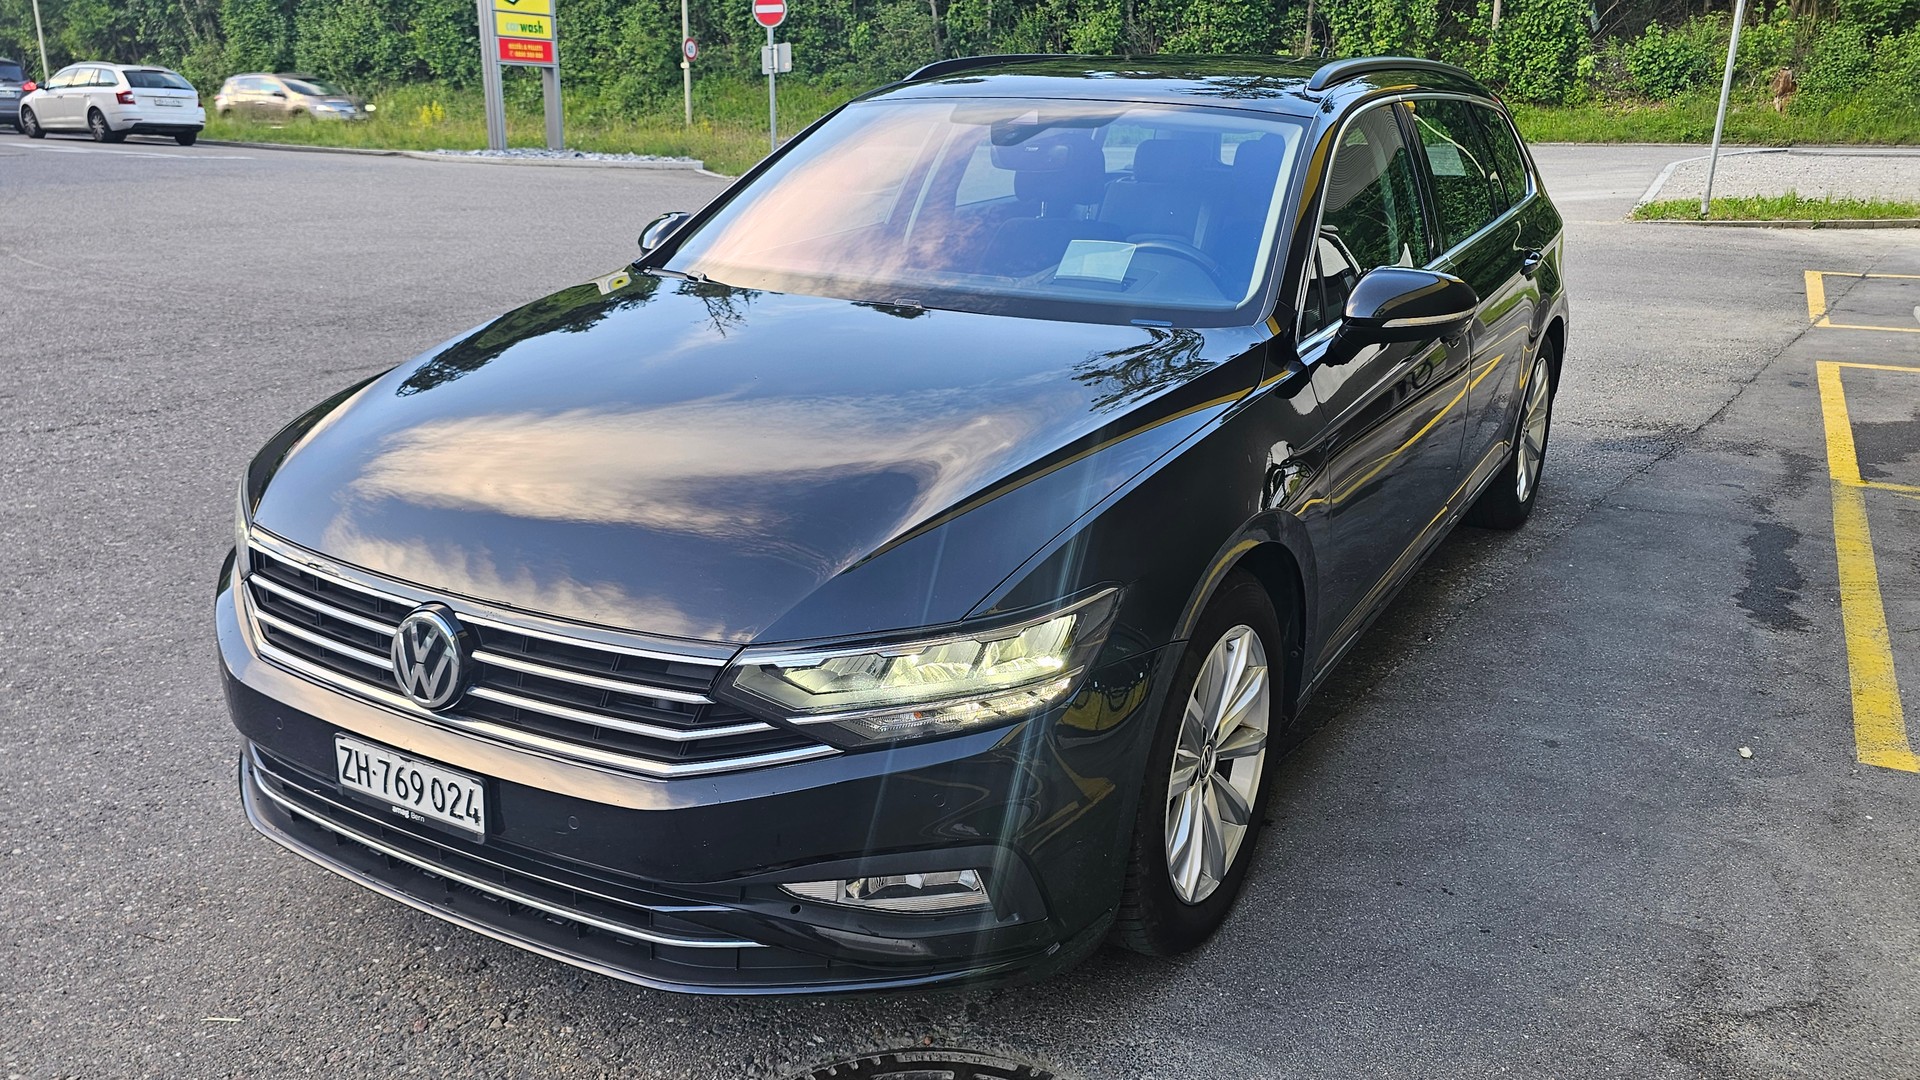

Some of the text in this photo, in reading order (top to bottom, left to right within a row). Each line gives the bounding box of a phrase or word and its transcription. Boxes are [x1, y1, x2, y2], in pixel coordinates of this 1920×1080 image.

[505, 20, 544, 35] carwash
[393, 613, 459, 706] VW
[410, 811, 426, 823] Bern
[431, 777, 482, 827] 024
